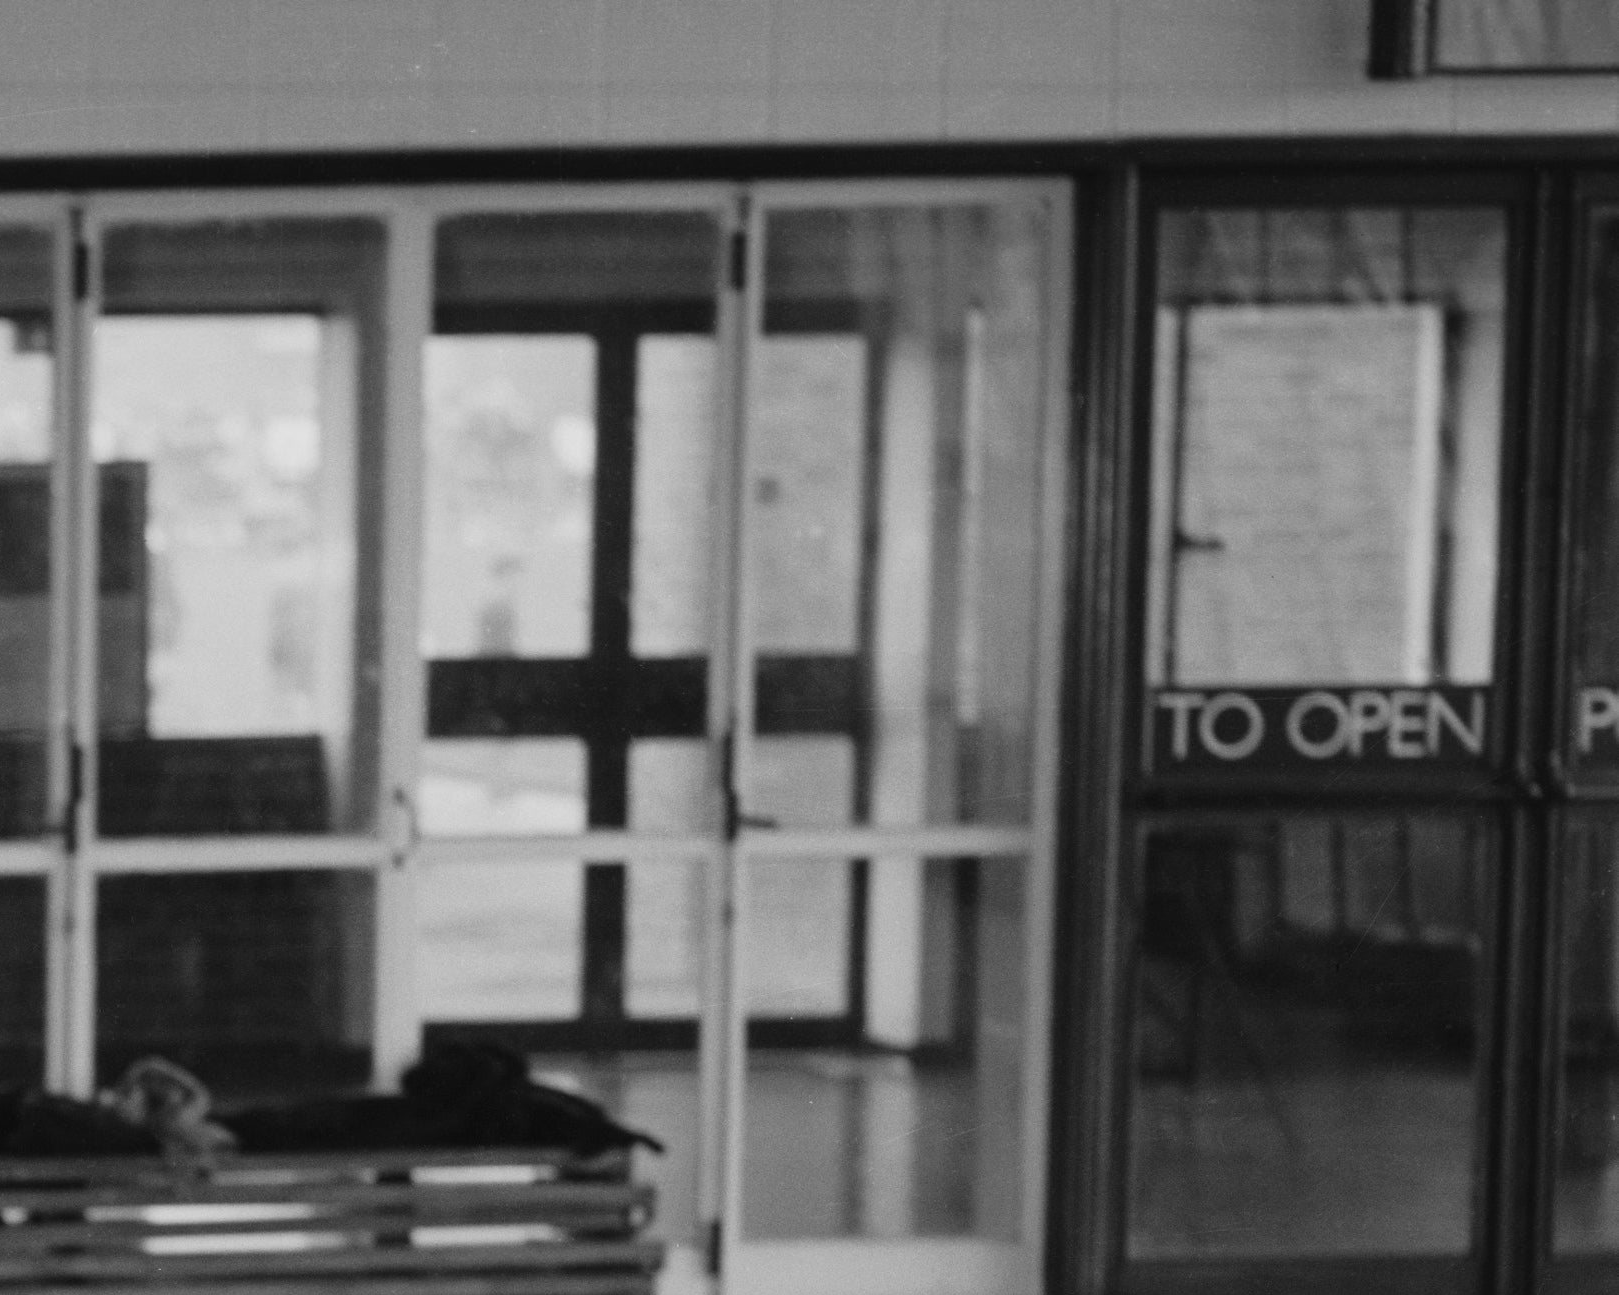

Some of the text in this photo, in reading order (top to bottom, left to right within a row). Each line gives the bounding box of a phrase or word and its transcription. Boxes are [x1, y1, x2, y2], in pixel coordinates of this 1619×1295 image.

[1158, 691, 1485, 761] TO OPEN
[1578, 688, 1619, 753] P
